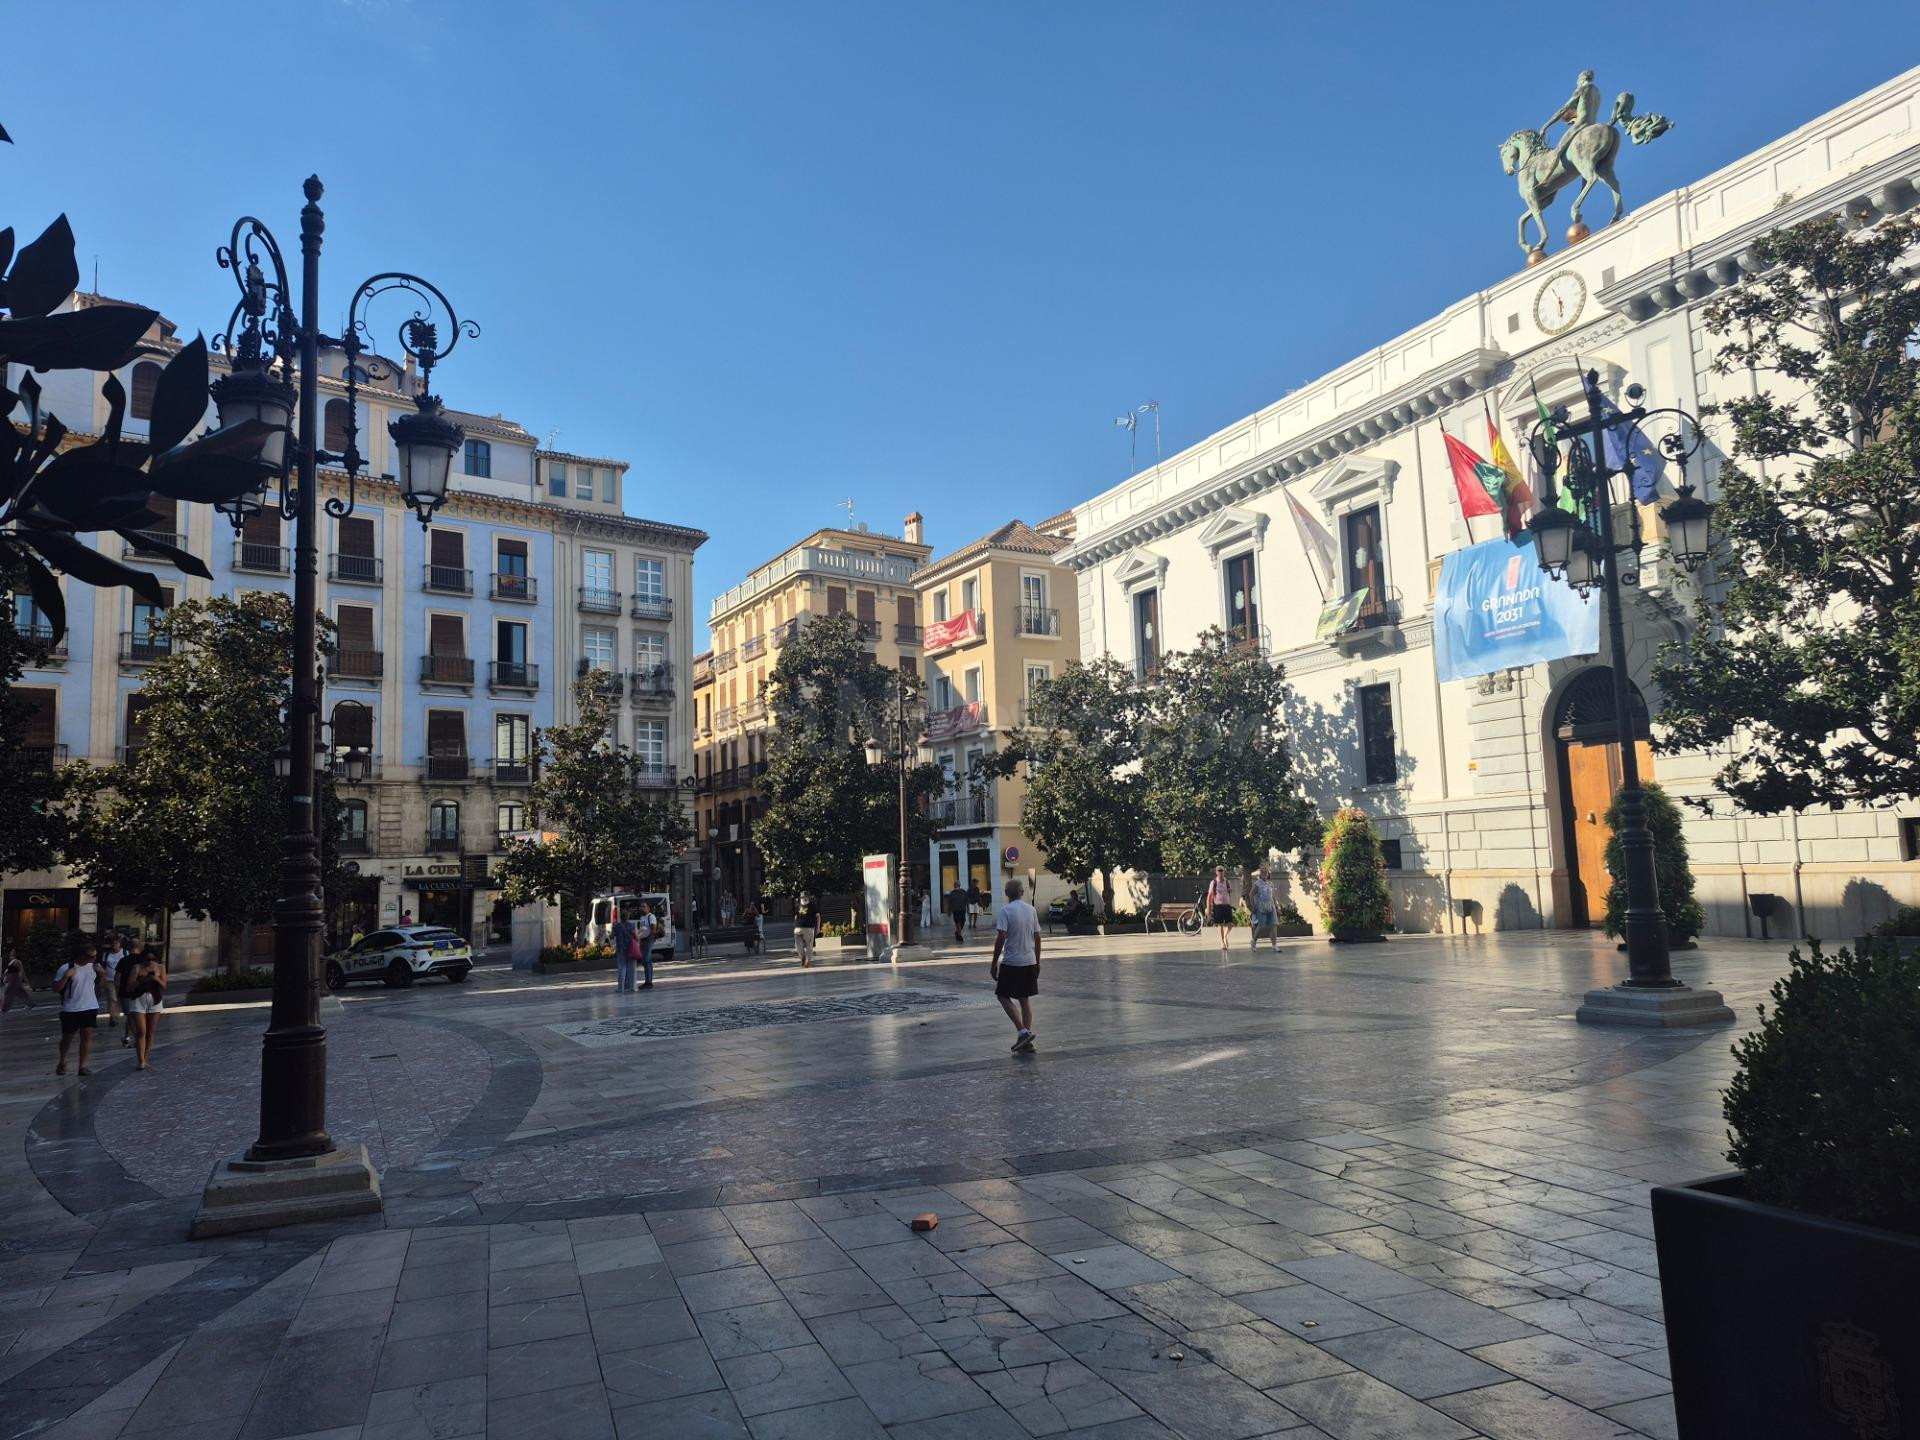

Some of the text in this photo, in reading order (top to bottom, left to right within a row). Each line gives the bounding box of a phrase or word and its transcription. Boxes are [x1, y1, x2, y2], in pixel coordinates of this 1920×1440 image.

[1482, 587, 1539, 611] GRANADA
[1497, 606, 1523, 623] 2031
[405, 865, 462, 875] LA CUEV
